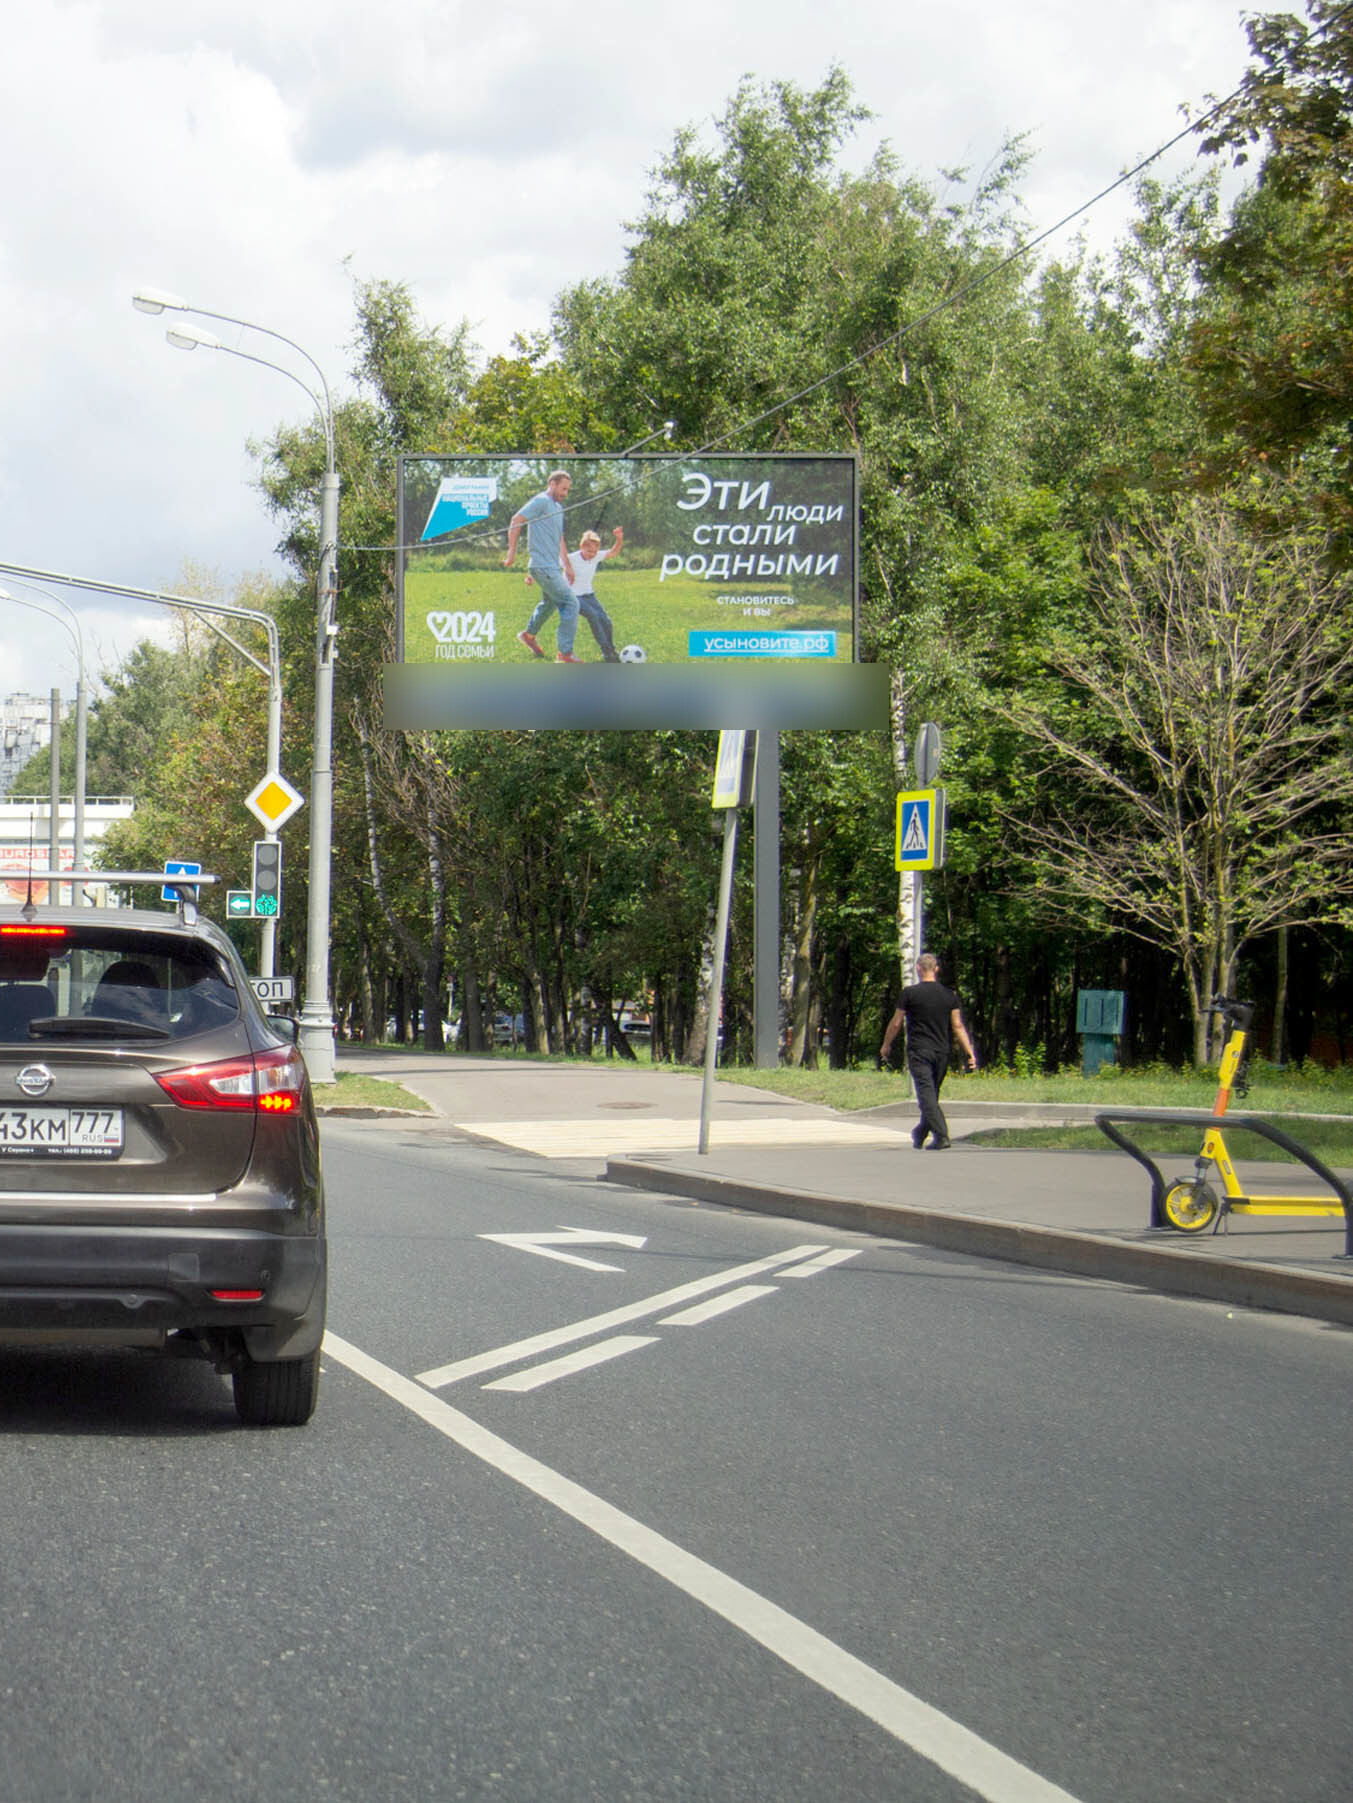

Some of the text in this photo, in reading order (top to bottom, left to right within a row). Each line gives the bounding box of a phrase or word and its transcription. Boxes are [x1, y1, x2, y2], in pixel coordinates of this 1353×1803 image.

[676, 472, 844, 525] Эти люди
[692, 524, 797, 546] стали
[658, 554, 840, 583] родными
[716, 596, 795, 606] СТАНОВИТЕСЬ
[743, 608, 771, 616] И ВЫ
[435, 611, 497, 642] 2024
[704, 635, 830, 652] усыновите.рф
[71, 1111, 114, 1133] 777
[81, 1134, 104, 1142] RUS
